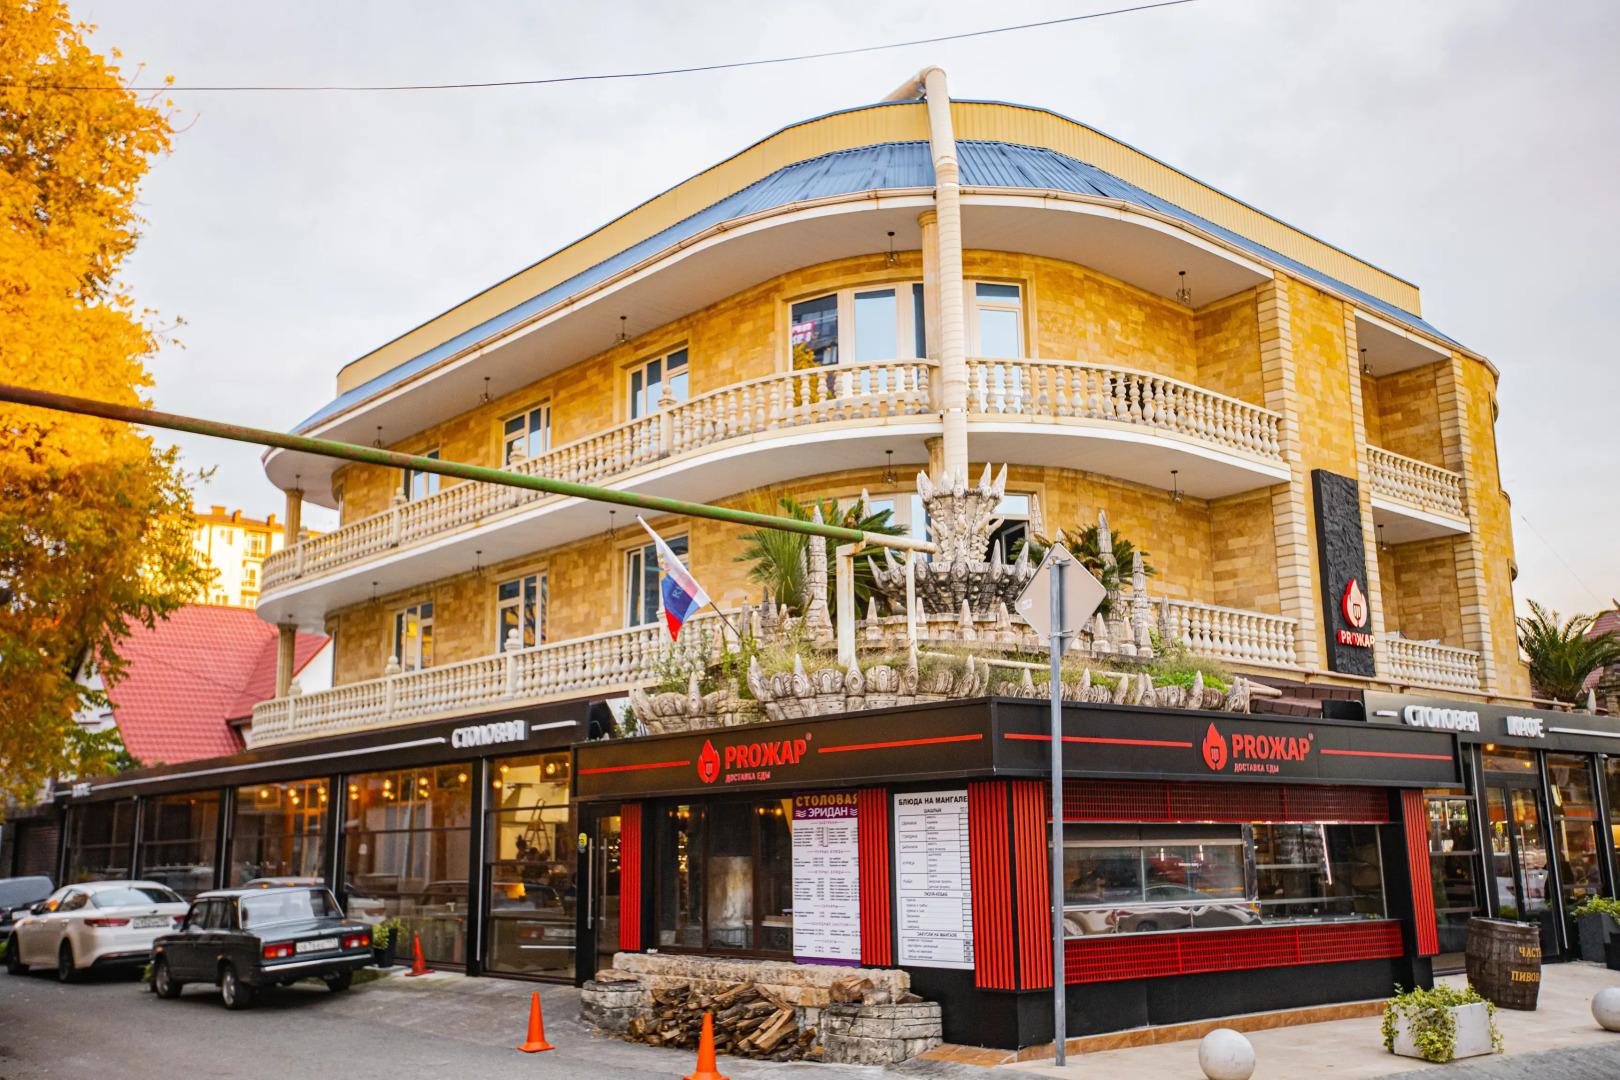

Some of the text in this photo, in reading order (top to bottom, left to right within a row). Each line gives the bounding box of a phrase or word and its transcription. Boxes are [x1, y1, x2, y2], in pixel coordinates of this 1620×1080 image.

[1404, 705, 1480, 732] СТОЛОВАЯ
[1506, 715, 1545, 738] КАФЕ
[1234, 763, 1279, 774] ДОСТАВКА ЕДЫ
[725, 771, 771, 783] ДОСТАВКА ЕДЫ
[898, 798, 923, 806] БЛЮДА
[935, 795, 968, 804] МАНГАЛЕ
[808, 806, 848, 818] ЭРИДАН
